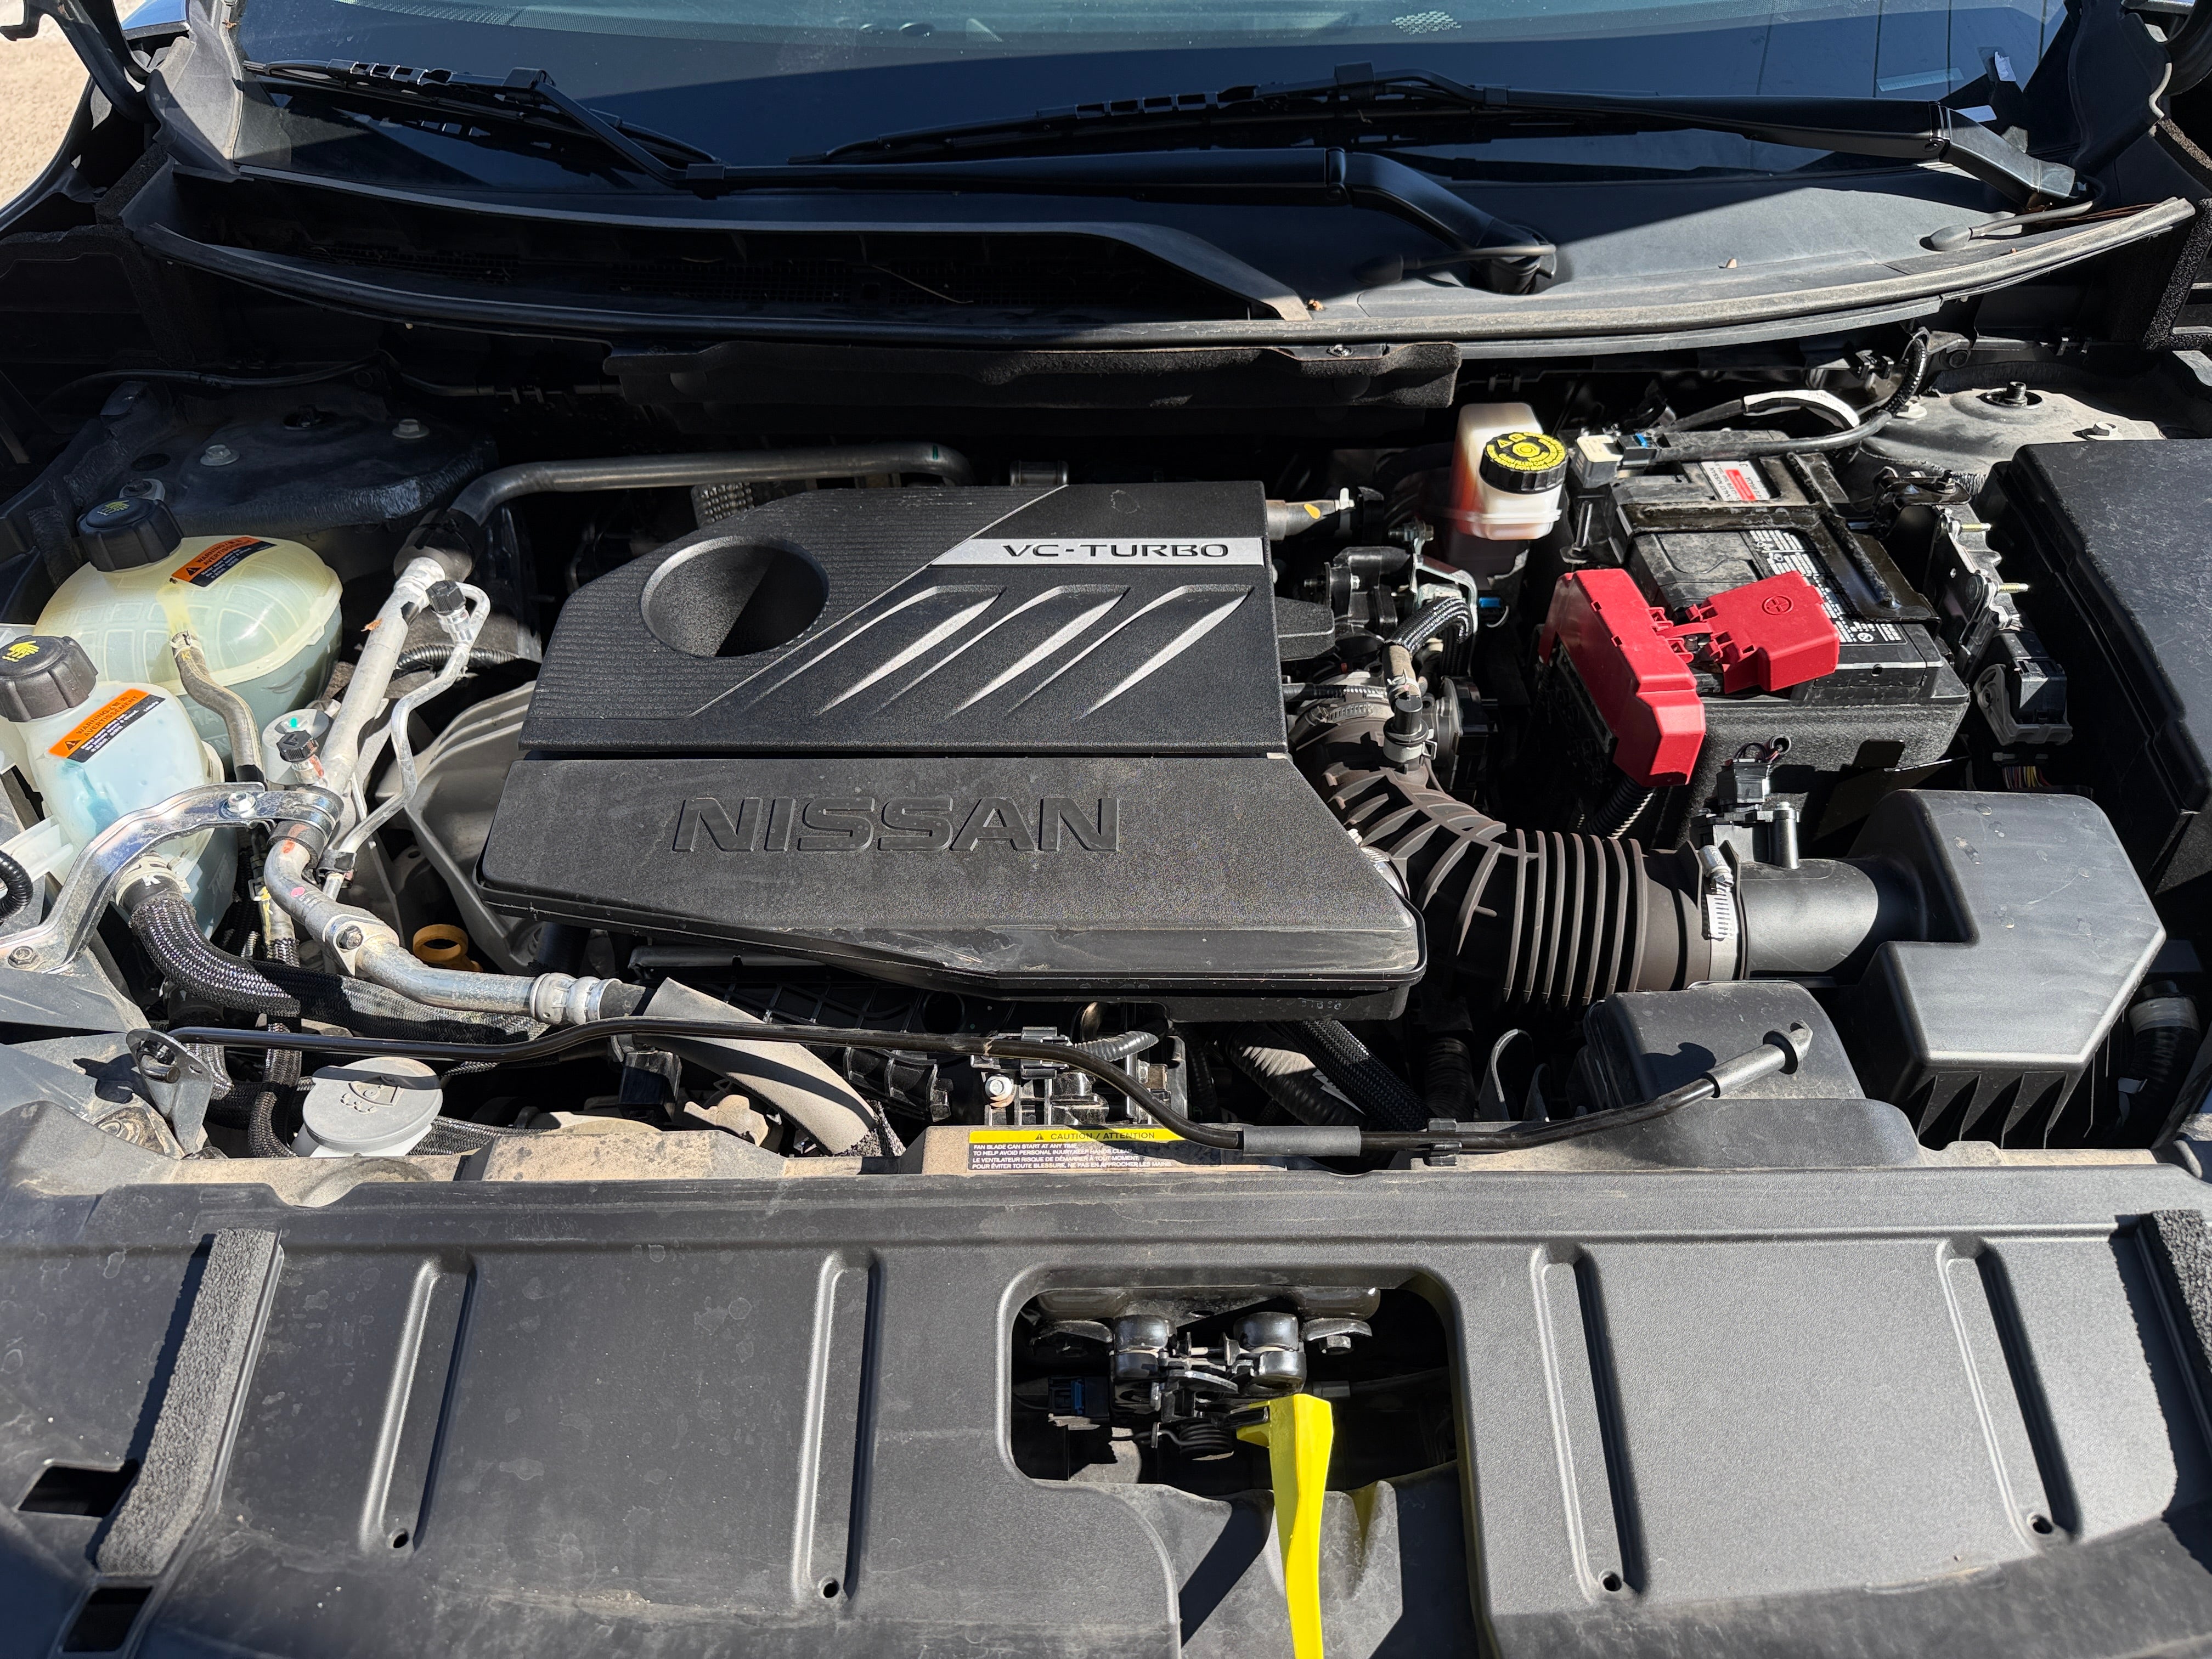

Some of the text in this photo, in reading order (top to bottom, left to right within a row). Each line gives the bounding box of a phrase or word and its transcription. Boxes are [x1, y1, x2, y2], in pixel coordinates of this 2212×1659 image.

[195, 543, 225, 563] WARNING
[1001, 544, 1228, 557] VC-TURBO
[76, 710, 109, 735] WARNING
[672, 797, 1120, 852] NISSAN
